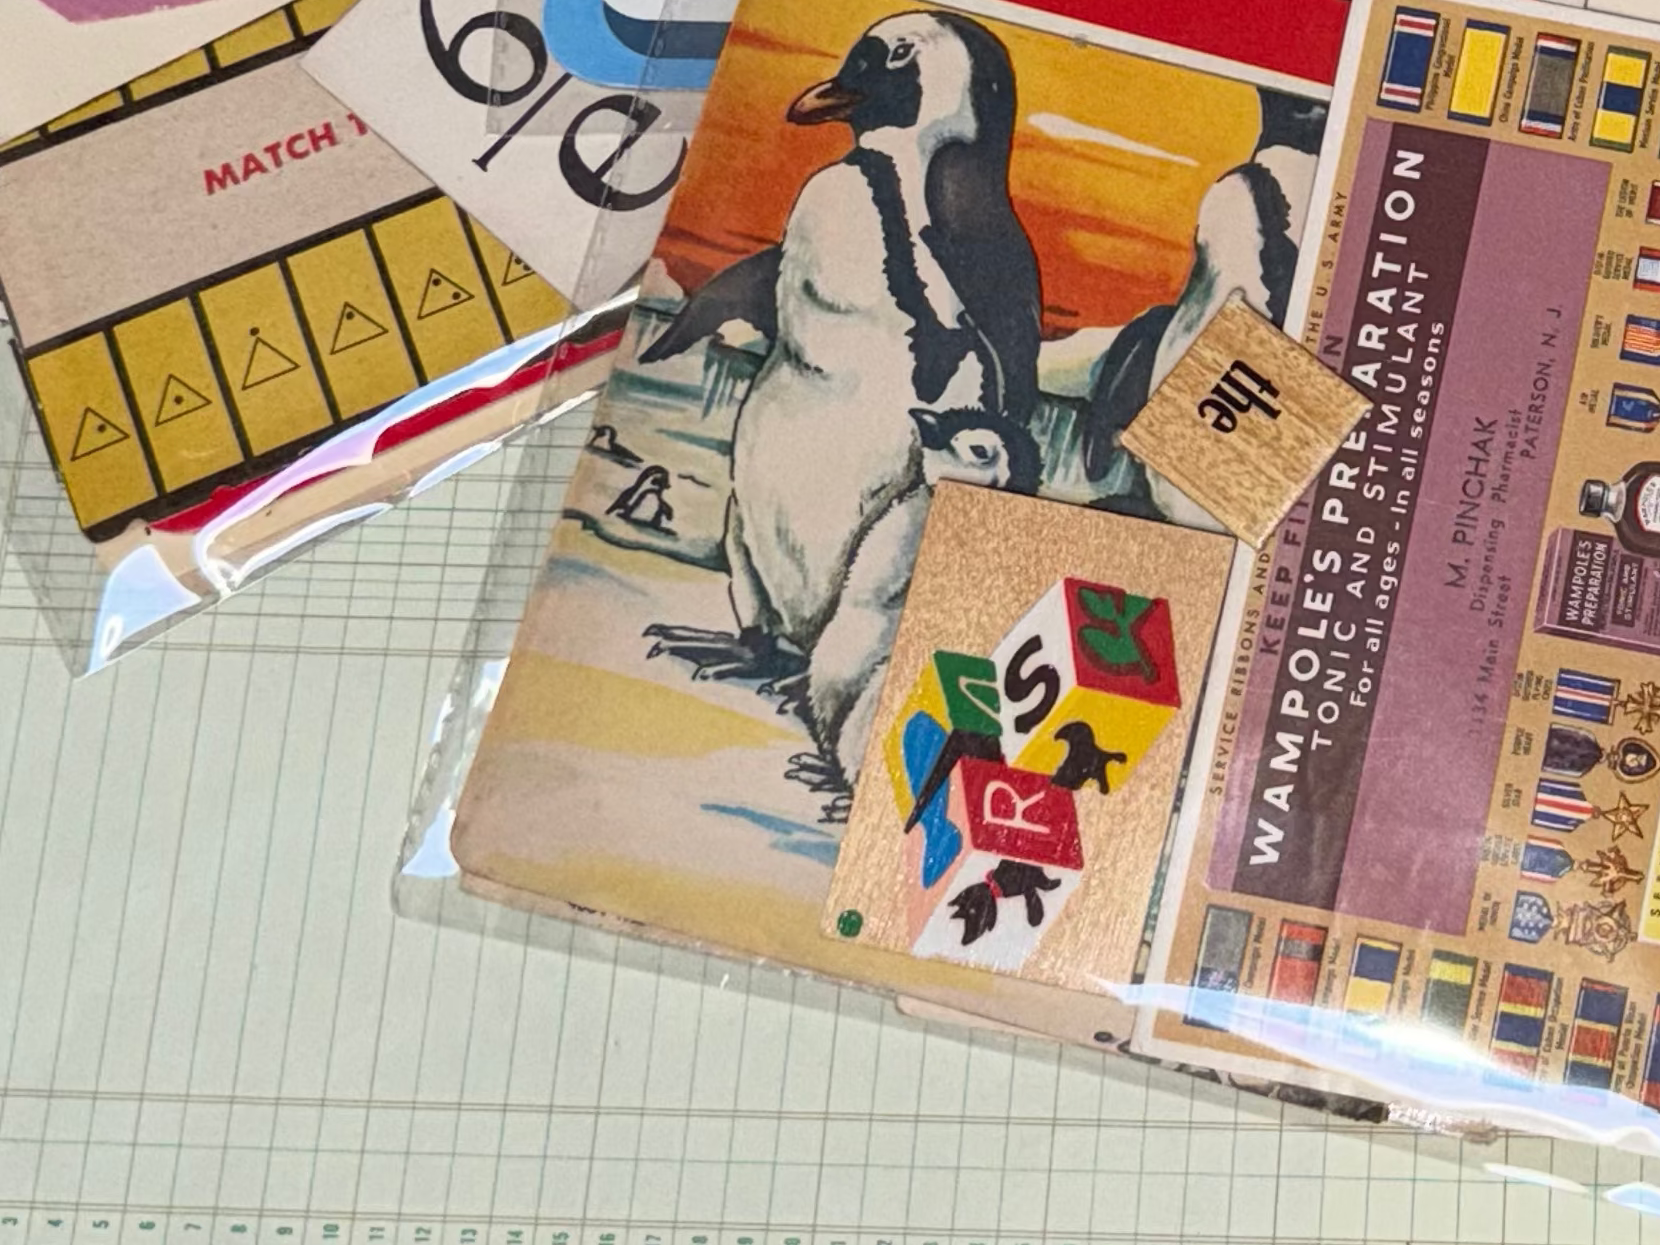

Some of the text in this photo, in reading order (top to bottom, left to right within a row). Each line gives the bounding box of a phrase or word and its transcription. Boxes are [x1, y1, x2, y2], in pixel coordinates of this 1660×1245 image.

[203, 121, 338, 196] MATCH
[558, 93, 689, 213] e
[1198, 359, 1282, 436] the
[1521, 355, 1557, 459] PATERSON,
[1210, 709, 1240, 796] SERVICE
[1230, 606, 1261, 697] RIBBONS
[1252, 551, 1272, 595] AND
[1304, 306, 1325, 344] THE
[1327, 190, 1349, 243] ARMY
[1244, 145, 1426, 869] WAMPOLE'S PREARATION
[1311, 261, 1432, 753] TONIC AND STIMULANT
[1350, 320, 1447, 707] For all ages In all seasons
[1444, 415, 1499, 589] M. PINCHAK
[1470, 407, 1525, 613] Dispensing Pharmacist
[1259, 564, 1296, 657] KEEP
[1479, 573, 1513, 683] Main Street
[1567, 538, 1591, 622] WAMPOLE'S
[1582, 541, 1608, 626] PREPARATION
[1005, 636, 1061, 732] S
[984, 782, 1050, 834] R
[93, 1220, 109, 1229] 5
